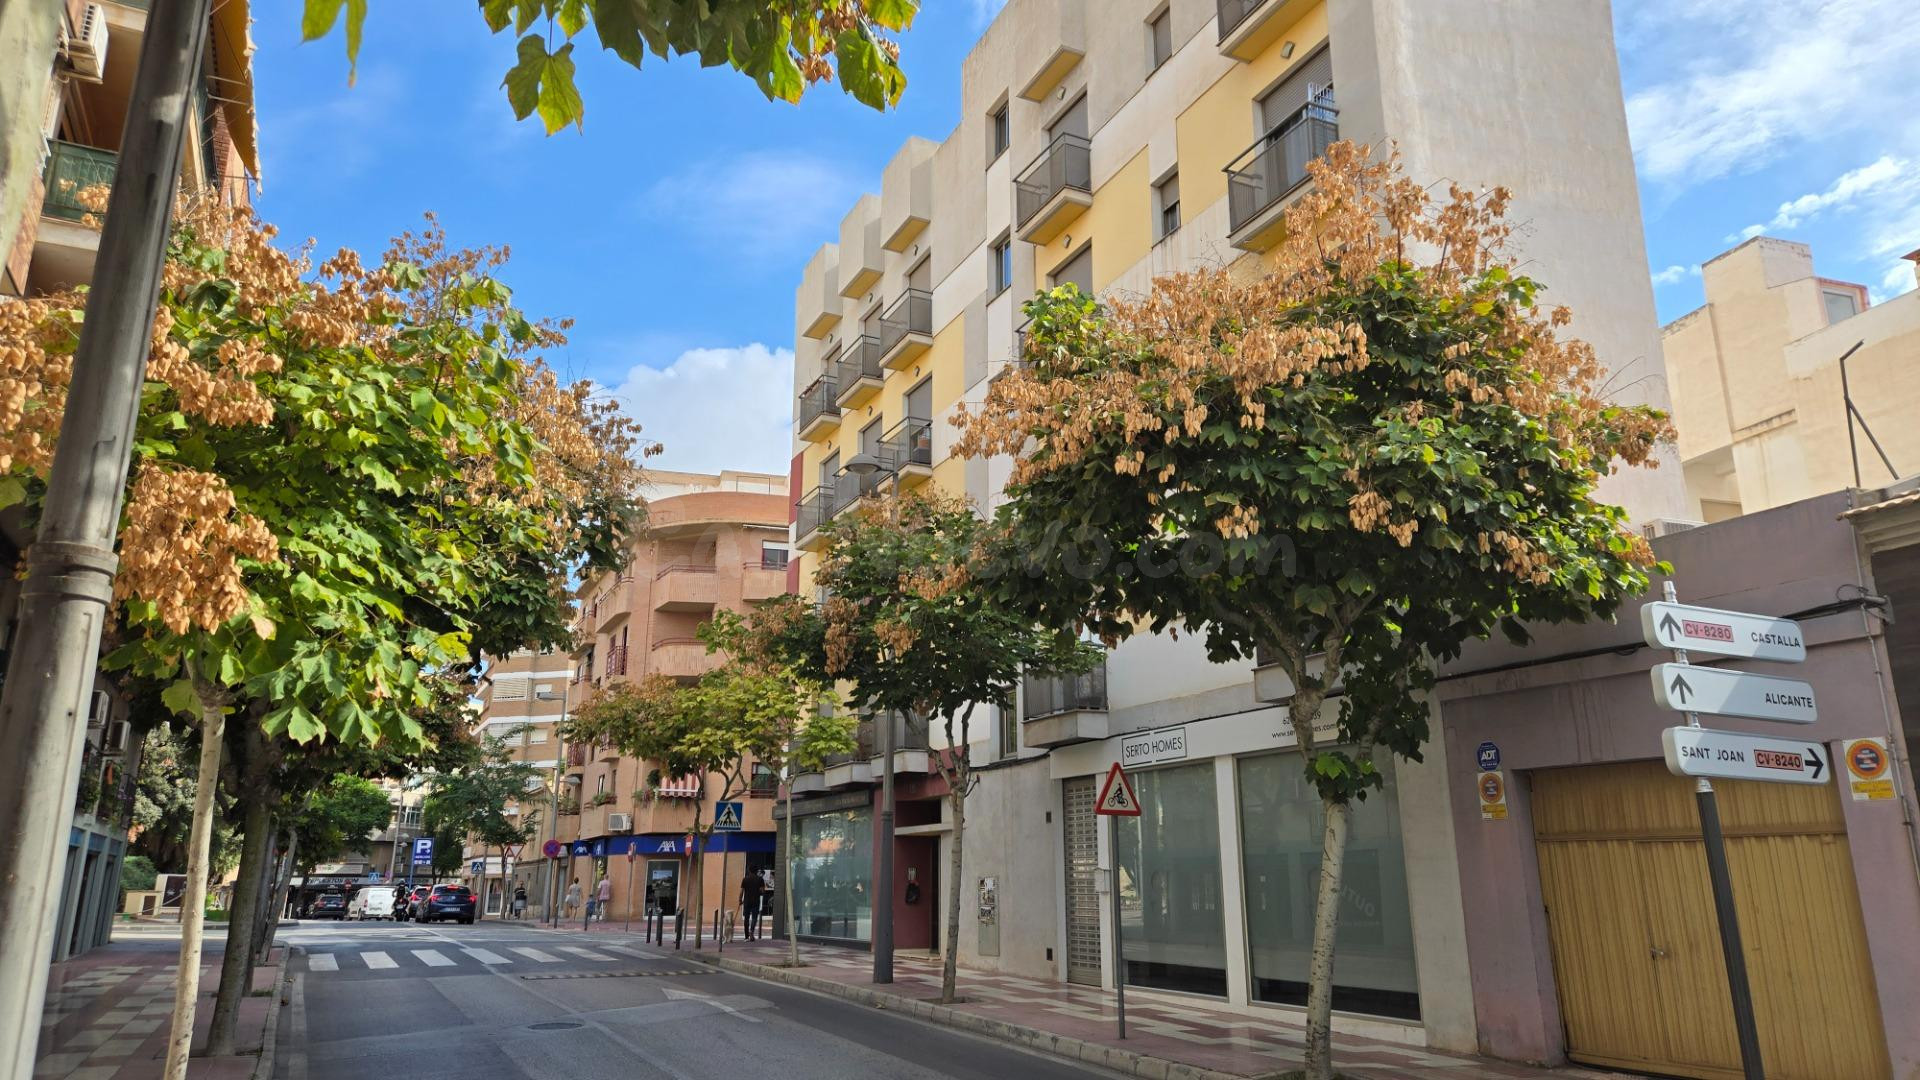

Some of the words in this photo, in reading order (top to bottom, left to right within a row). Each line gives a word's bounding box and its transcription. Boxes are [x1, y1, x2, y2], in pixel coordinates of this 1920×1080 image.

[1685, 623, 1731, 640] CV-8280
[1750, 632, 1801, 648] CASTALLA
[1765, 693, 1813, 708] ALICANTE
[1125, 742, 1150, 758] SERTO
[1151, 736, 1183, 754] HOMES
[1481, 749, 1496, 761] ADT
[1681, 746, 1711, 760] SANT
[1717, 749, 1745, 762] JOAN
[1756, 752, 1801, 768] CV-8240
[416, 839, 432, 854] P
[656, 840, 676, 853] AXA
